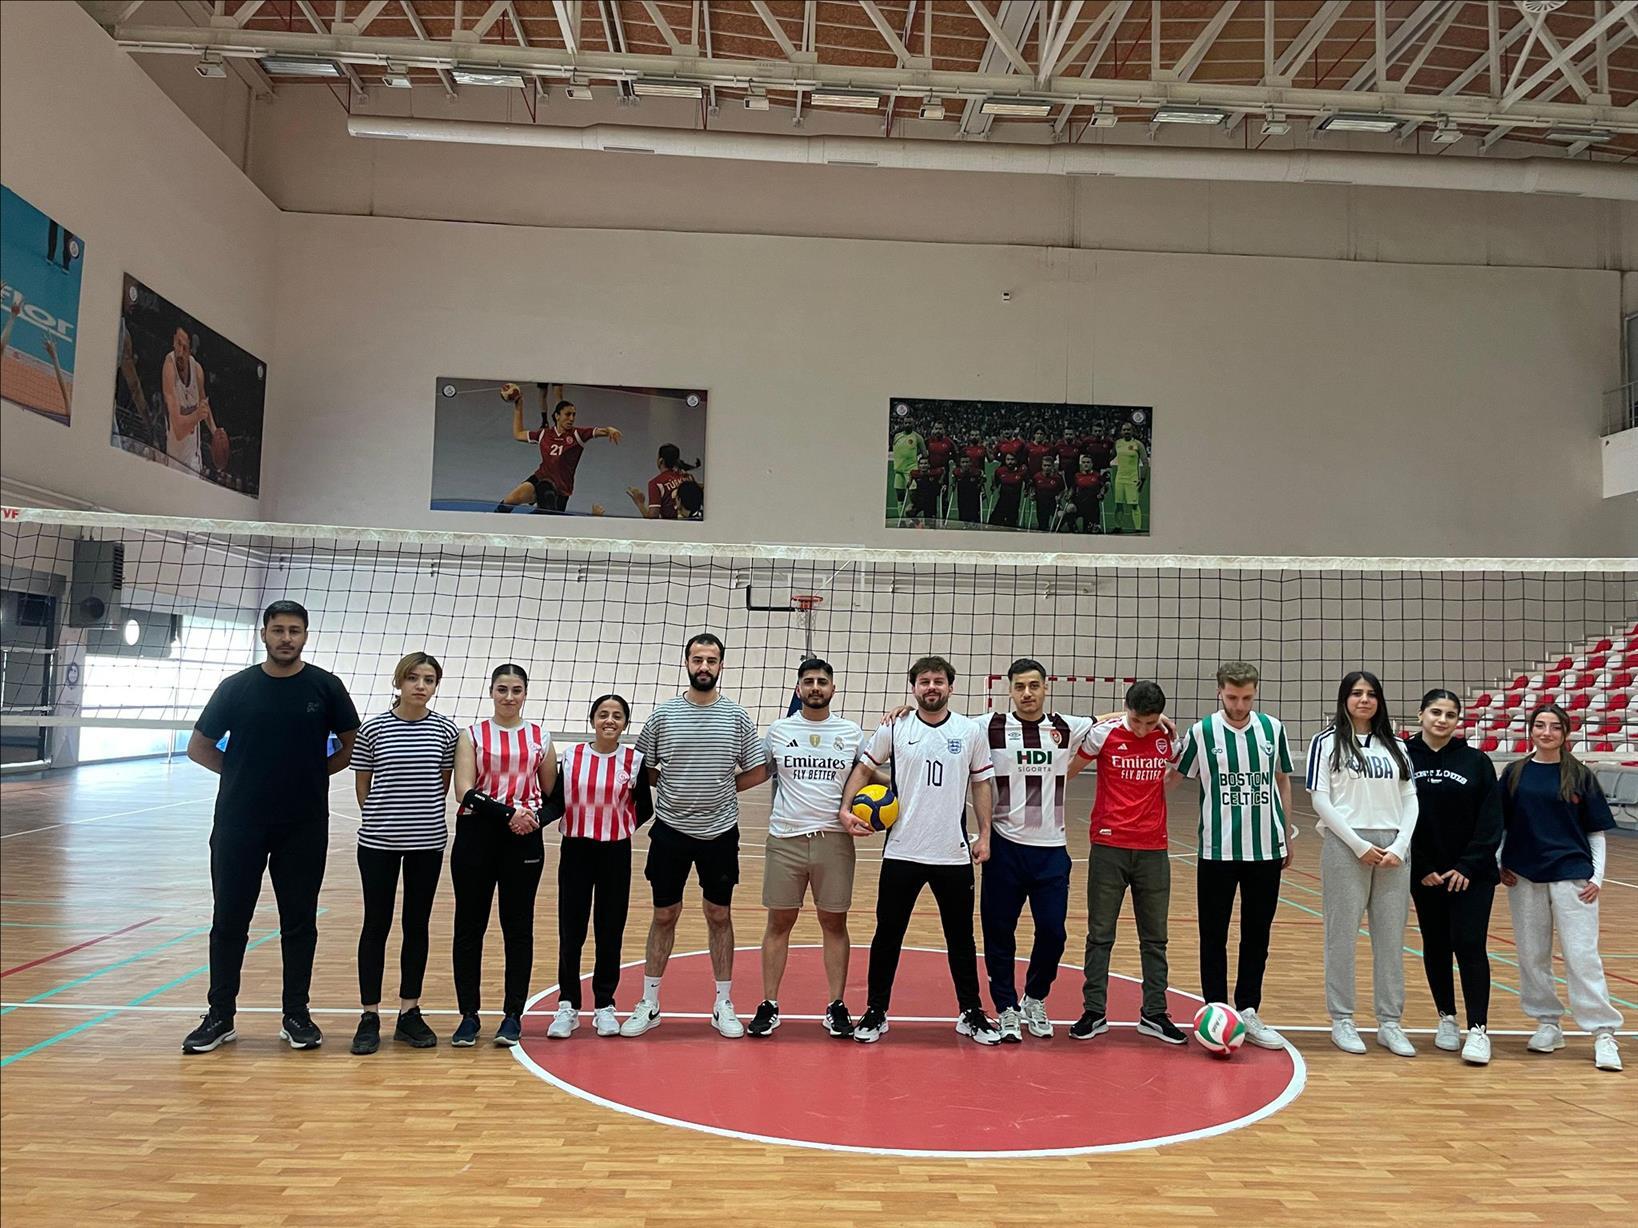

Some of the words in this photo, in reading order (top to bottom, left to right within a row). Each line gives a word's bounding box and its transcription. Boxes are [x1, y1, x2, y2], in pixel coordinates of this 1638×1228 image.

[549, 444, 564, 456] 21
[784, 755, 846, 770] Emirates
[1016, 751, 1052, 764] HDI
[793, 769, 805, 780] FLY
[808, 769, 837, 781] BETTER
[925, 759, 943, 787] 10
[1363, 756, 1393, 779] NBA
[1219, 771, 1270, 787] BOSTON
